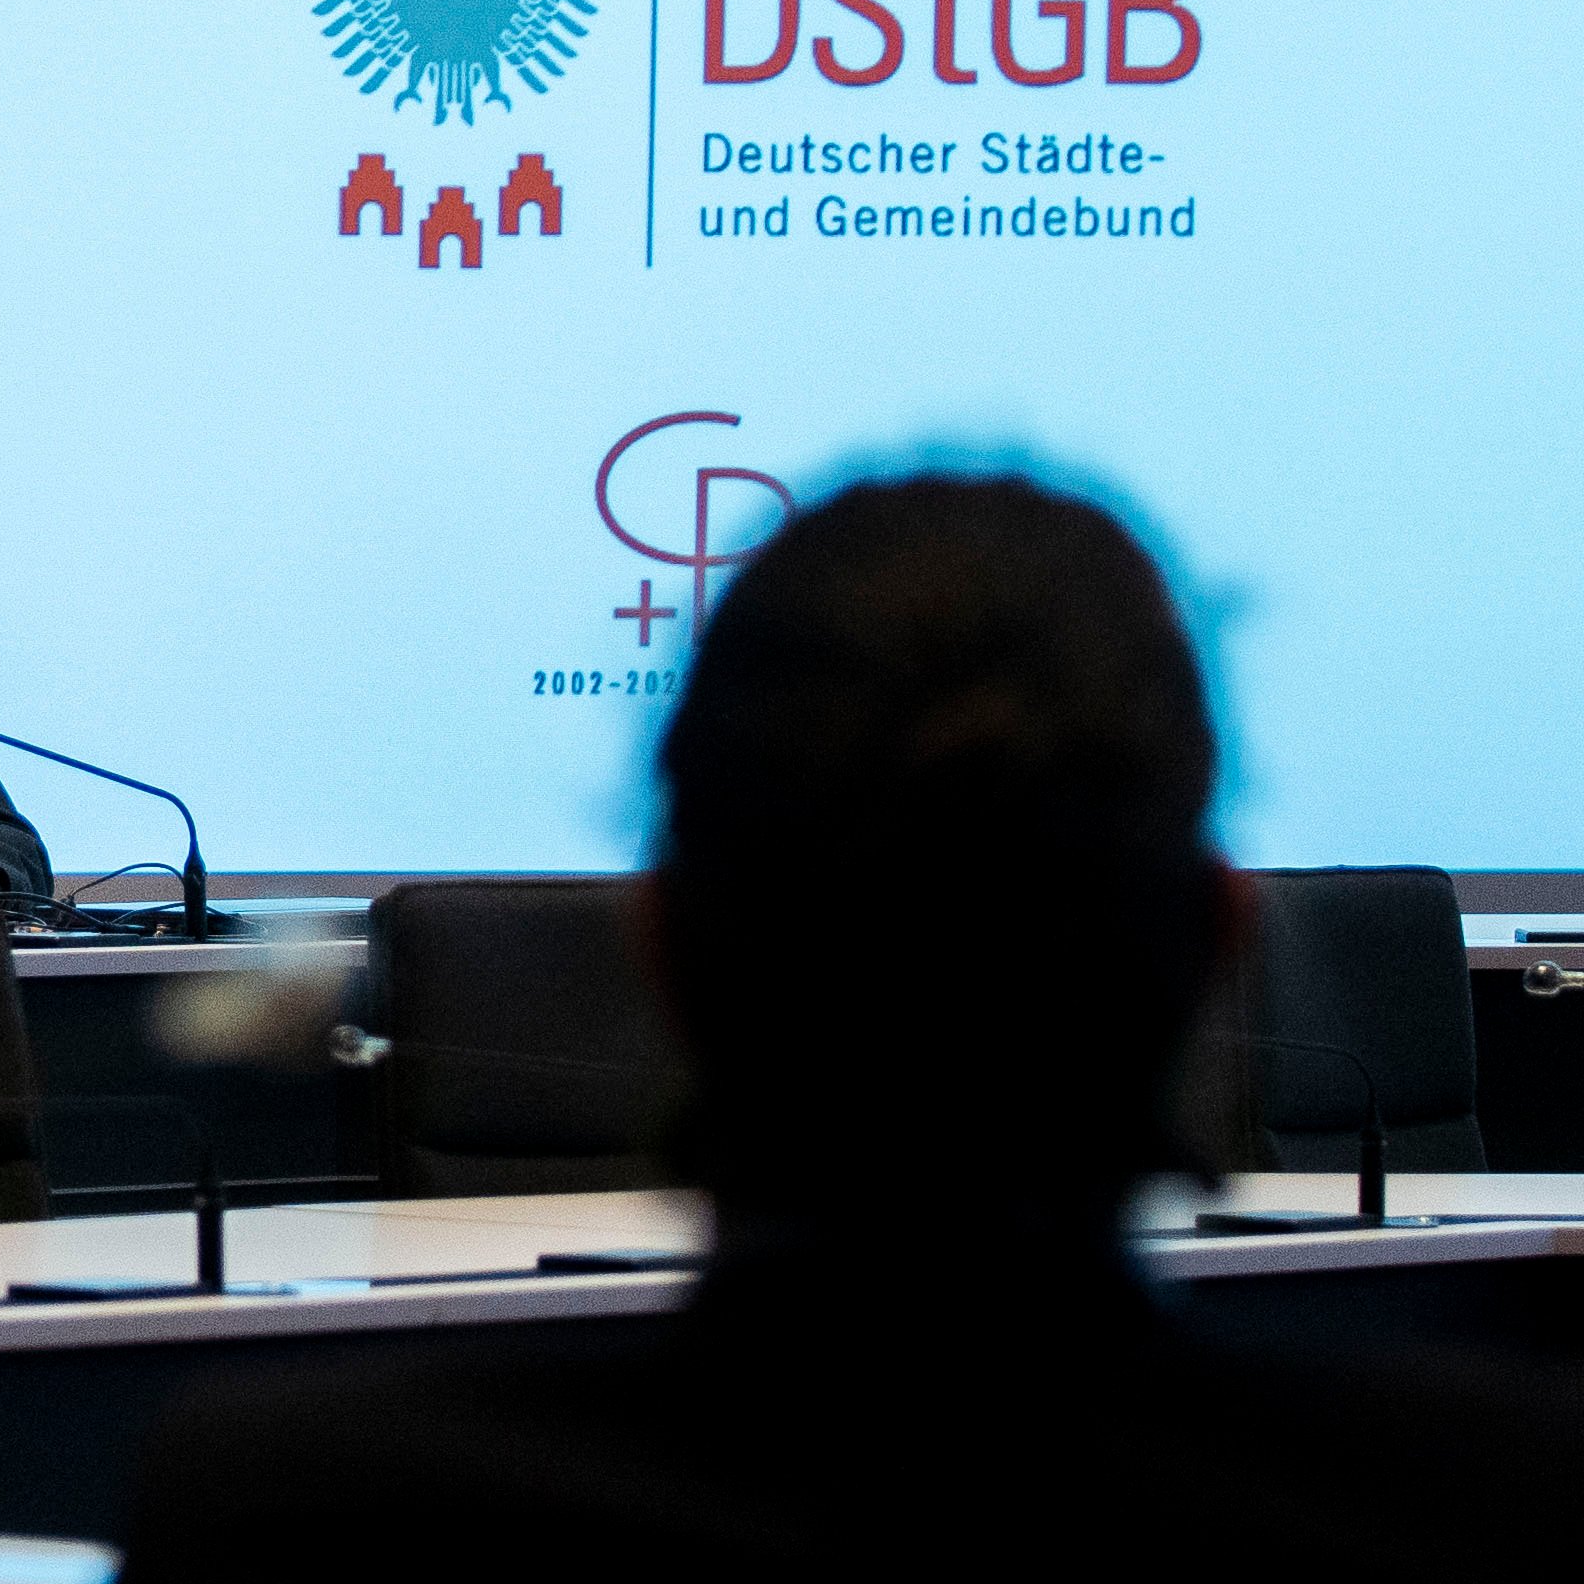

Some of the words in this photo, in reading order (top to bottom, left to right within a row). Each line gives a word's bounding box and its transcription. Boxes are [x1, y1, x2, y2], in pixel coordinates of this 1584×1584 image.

[703, 133, 956, 174] Deutscher
[981, 132, 1164, 174] Städte-
[700, 197, 789, 237] und
[815, 195, 1195, 237] Gemeindebund
[534, 670, 680, 695] 2002-202
